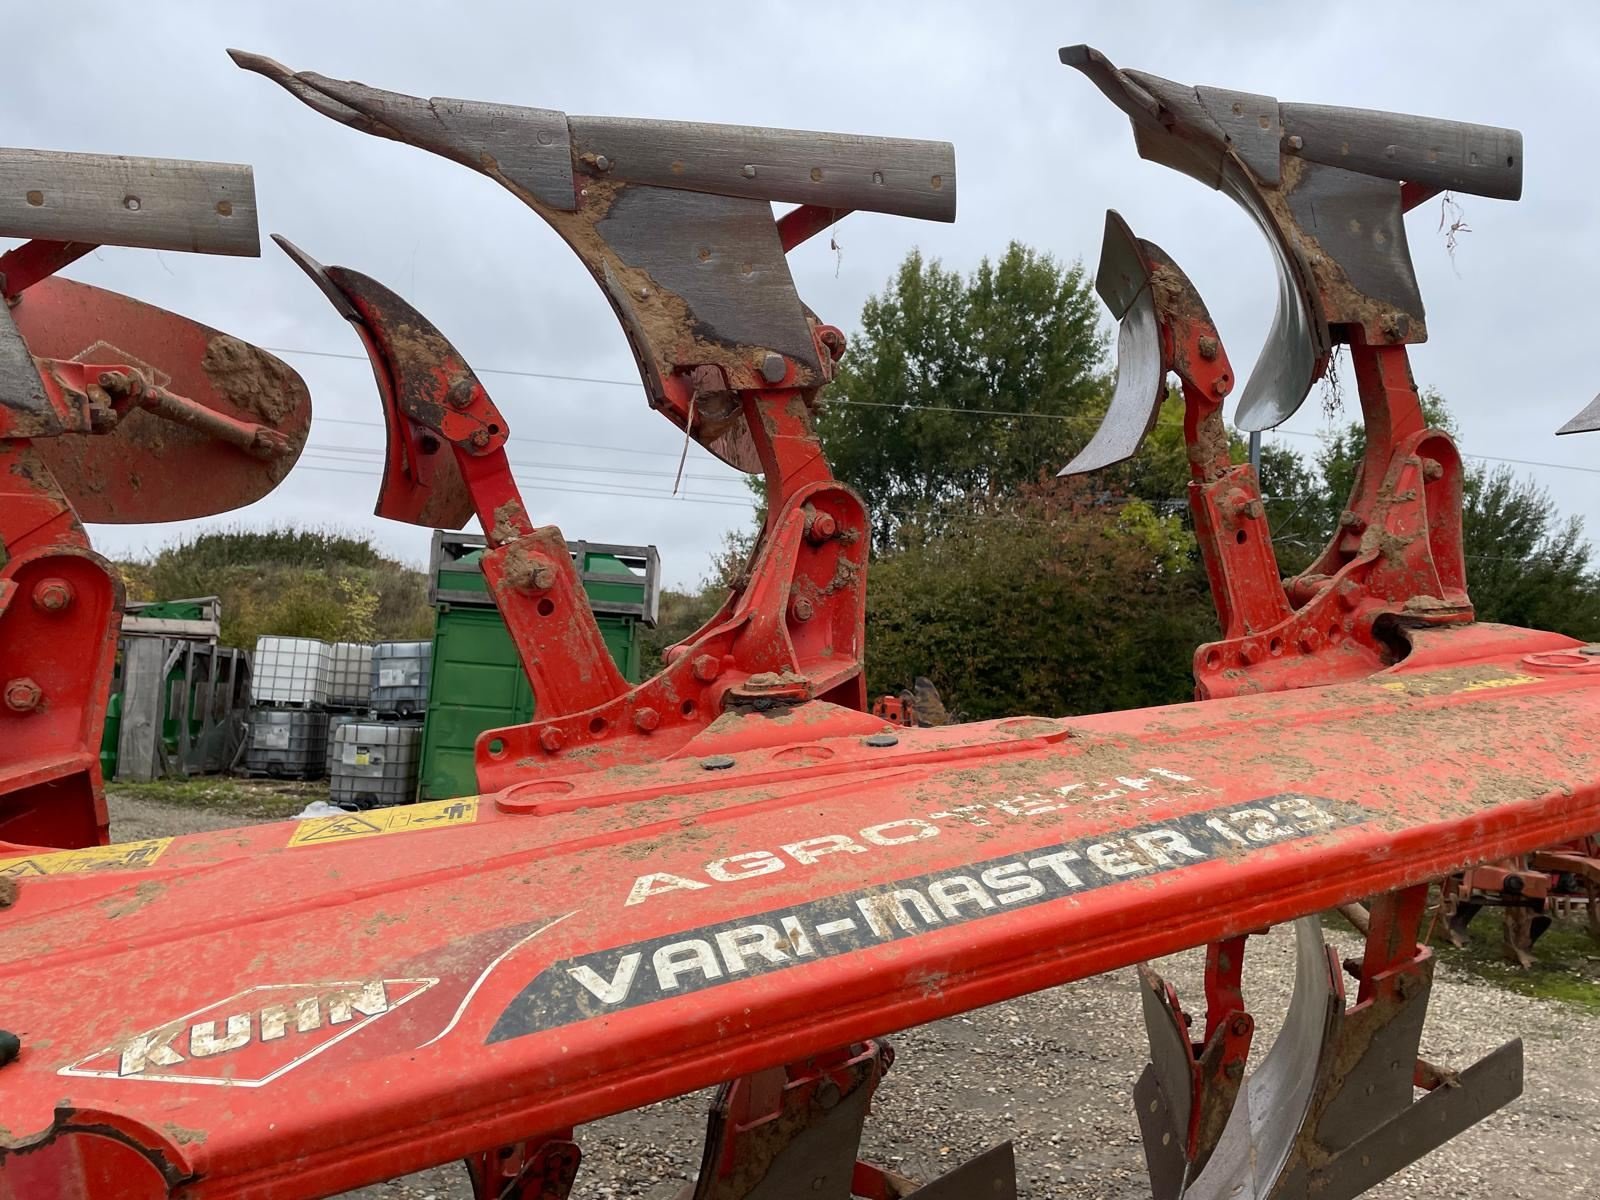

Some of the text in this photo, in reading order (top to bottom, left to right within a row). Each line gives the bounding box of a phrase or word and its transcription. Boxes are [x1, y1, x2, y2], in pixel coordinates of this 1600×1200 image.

[569, 798, 1336, 1006] VARI-MASTER 123
[119, 979, 389, 1077] KUHN
